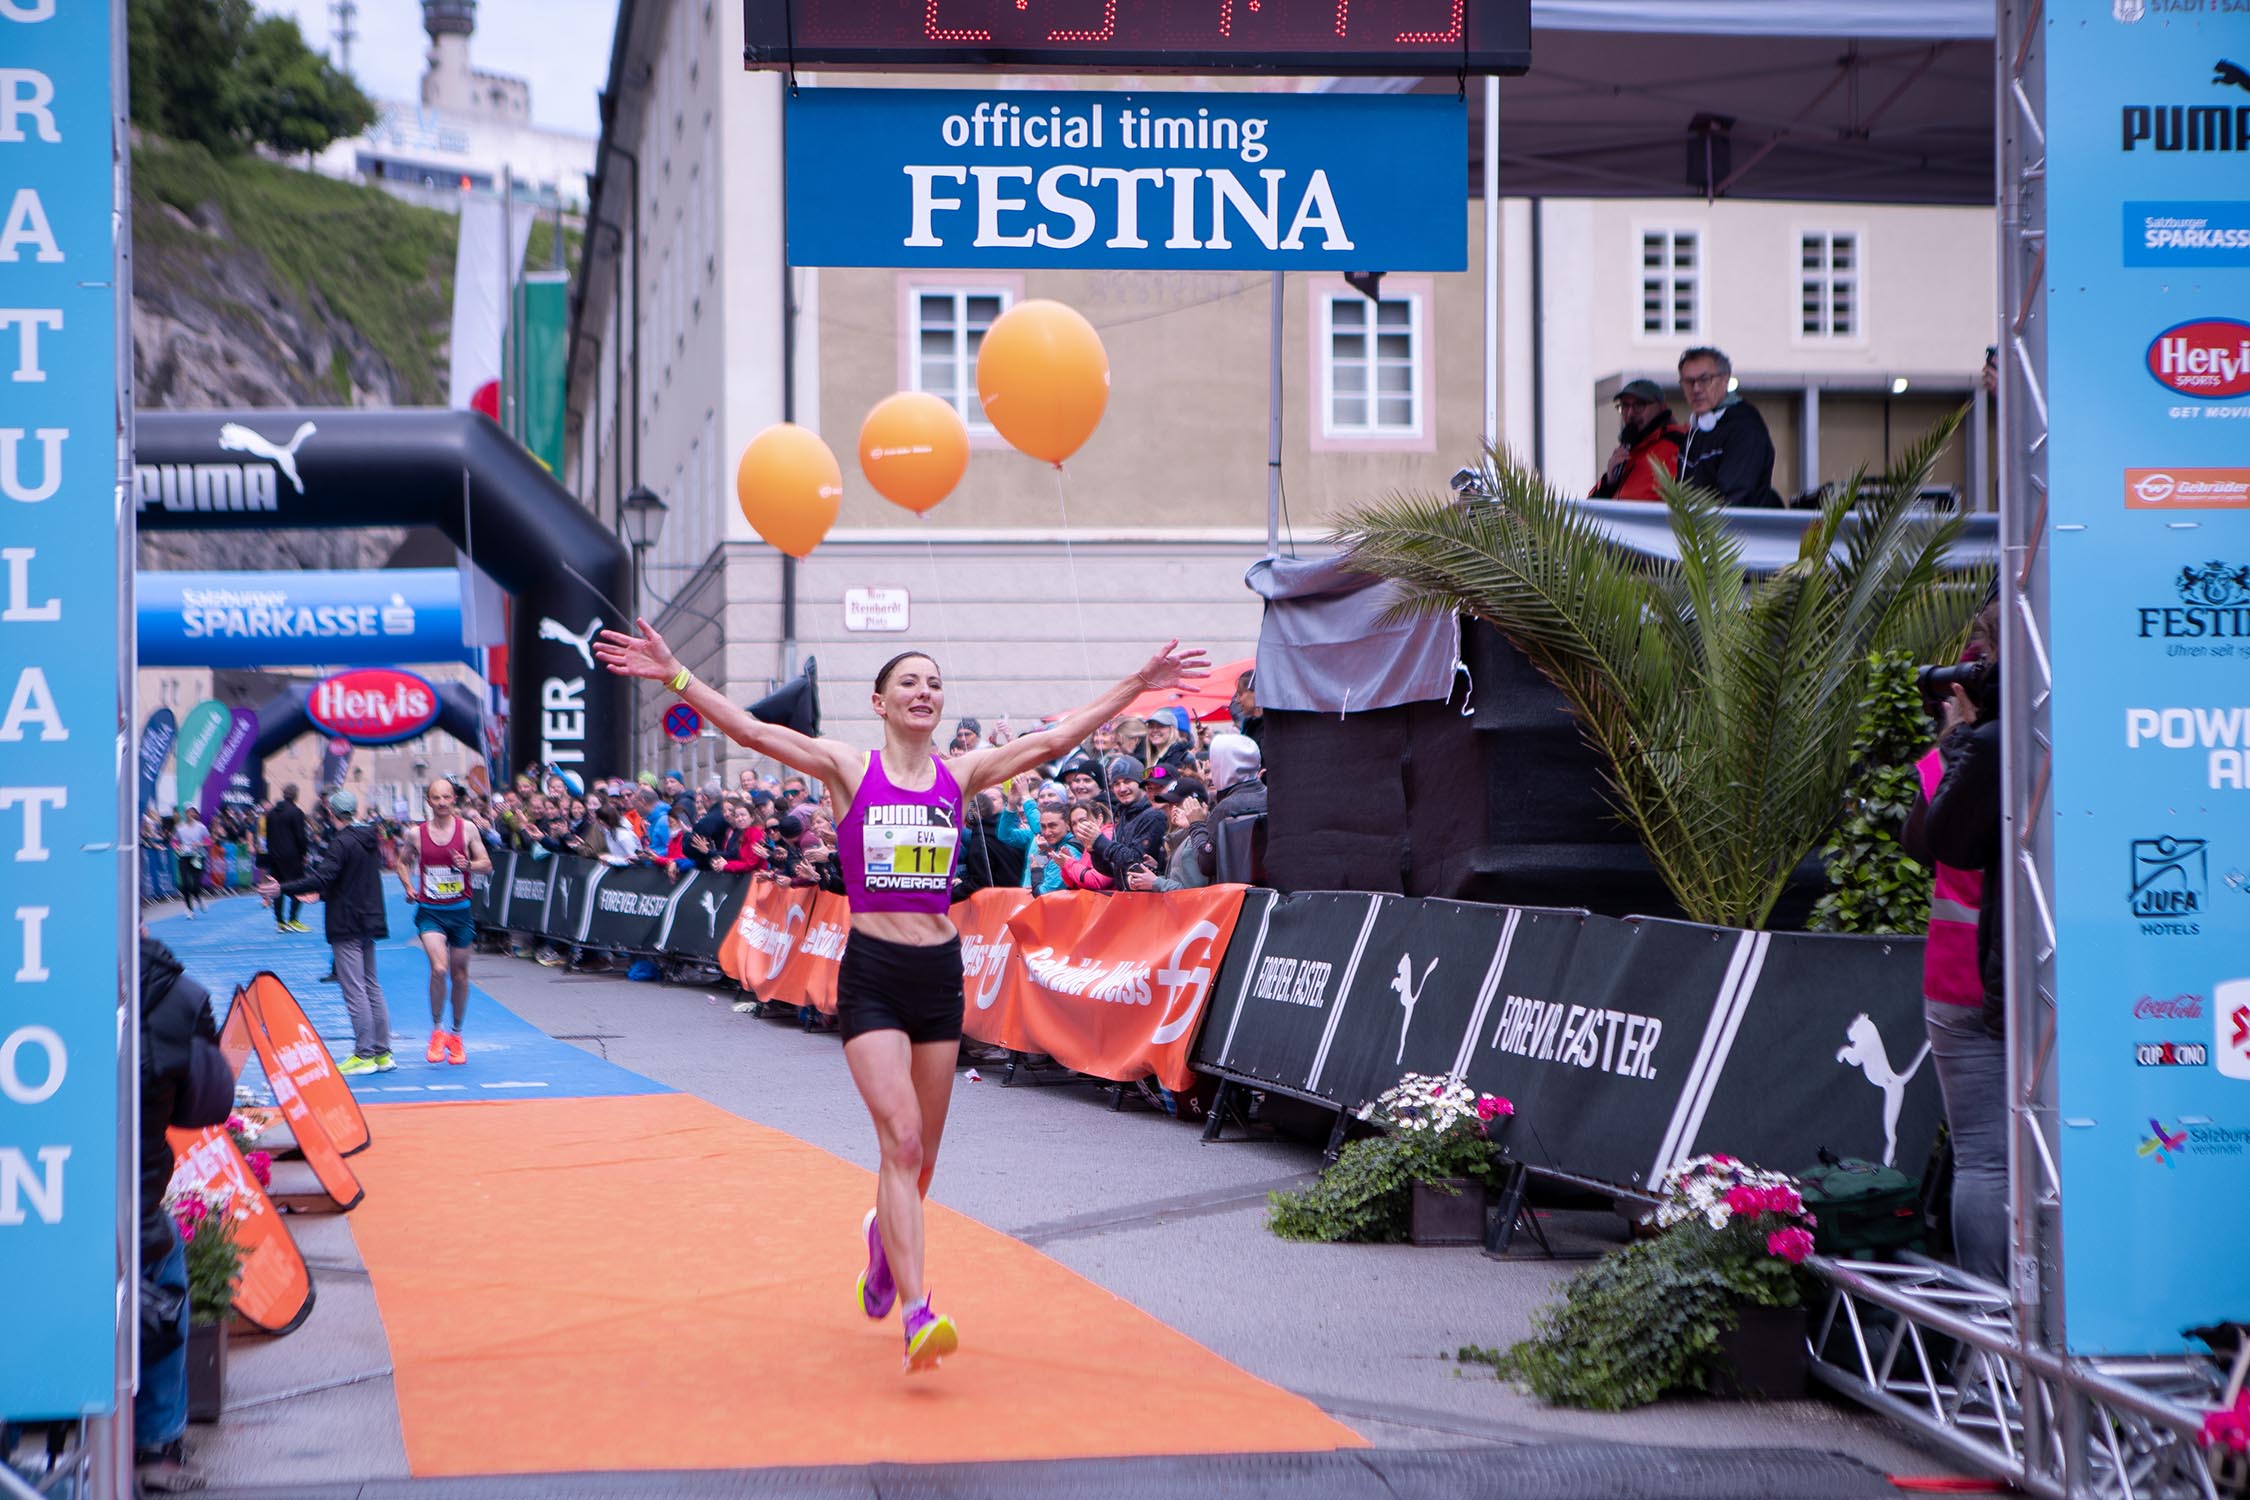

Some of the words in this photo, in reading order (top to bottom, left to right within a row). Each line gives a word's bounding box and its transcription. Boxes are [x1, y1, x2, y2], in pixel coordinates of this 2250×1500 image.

[941, 103, 1104, 149] official
[1119, 108, 1270, 163] timing
[903, 165, 1356, 252] FESTINA
[2144, 230, 2250, 249] SPARKASS
[2168, 406, 2200, 418] GET
[2205, 406, 2250, 418] MOVI
[135, 463, 279, 512] PUMA
[182, 606, 379, 638] SPARKASSE
[2138, 608, 2250, 637] FESTI
[318, 681, 430, 726] Hervis
[868, 805, 928, 825] PUMA
[917, 831, 936, 844] EVA
[912, 846, 937, 873] 11
[866, 876, 947, 889] POWERADE
[2142, 889, 2200, 912] JUFA
[2141, 922, 2200, 935] HOTELS
[1555, 1004, 1663, 1080] FASTER.
